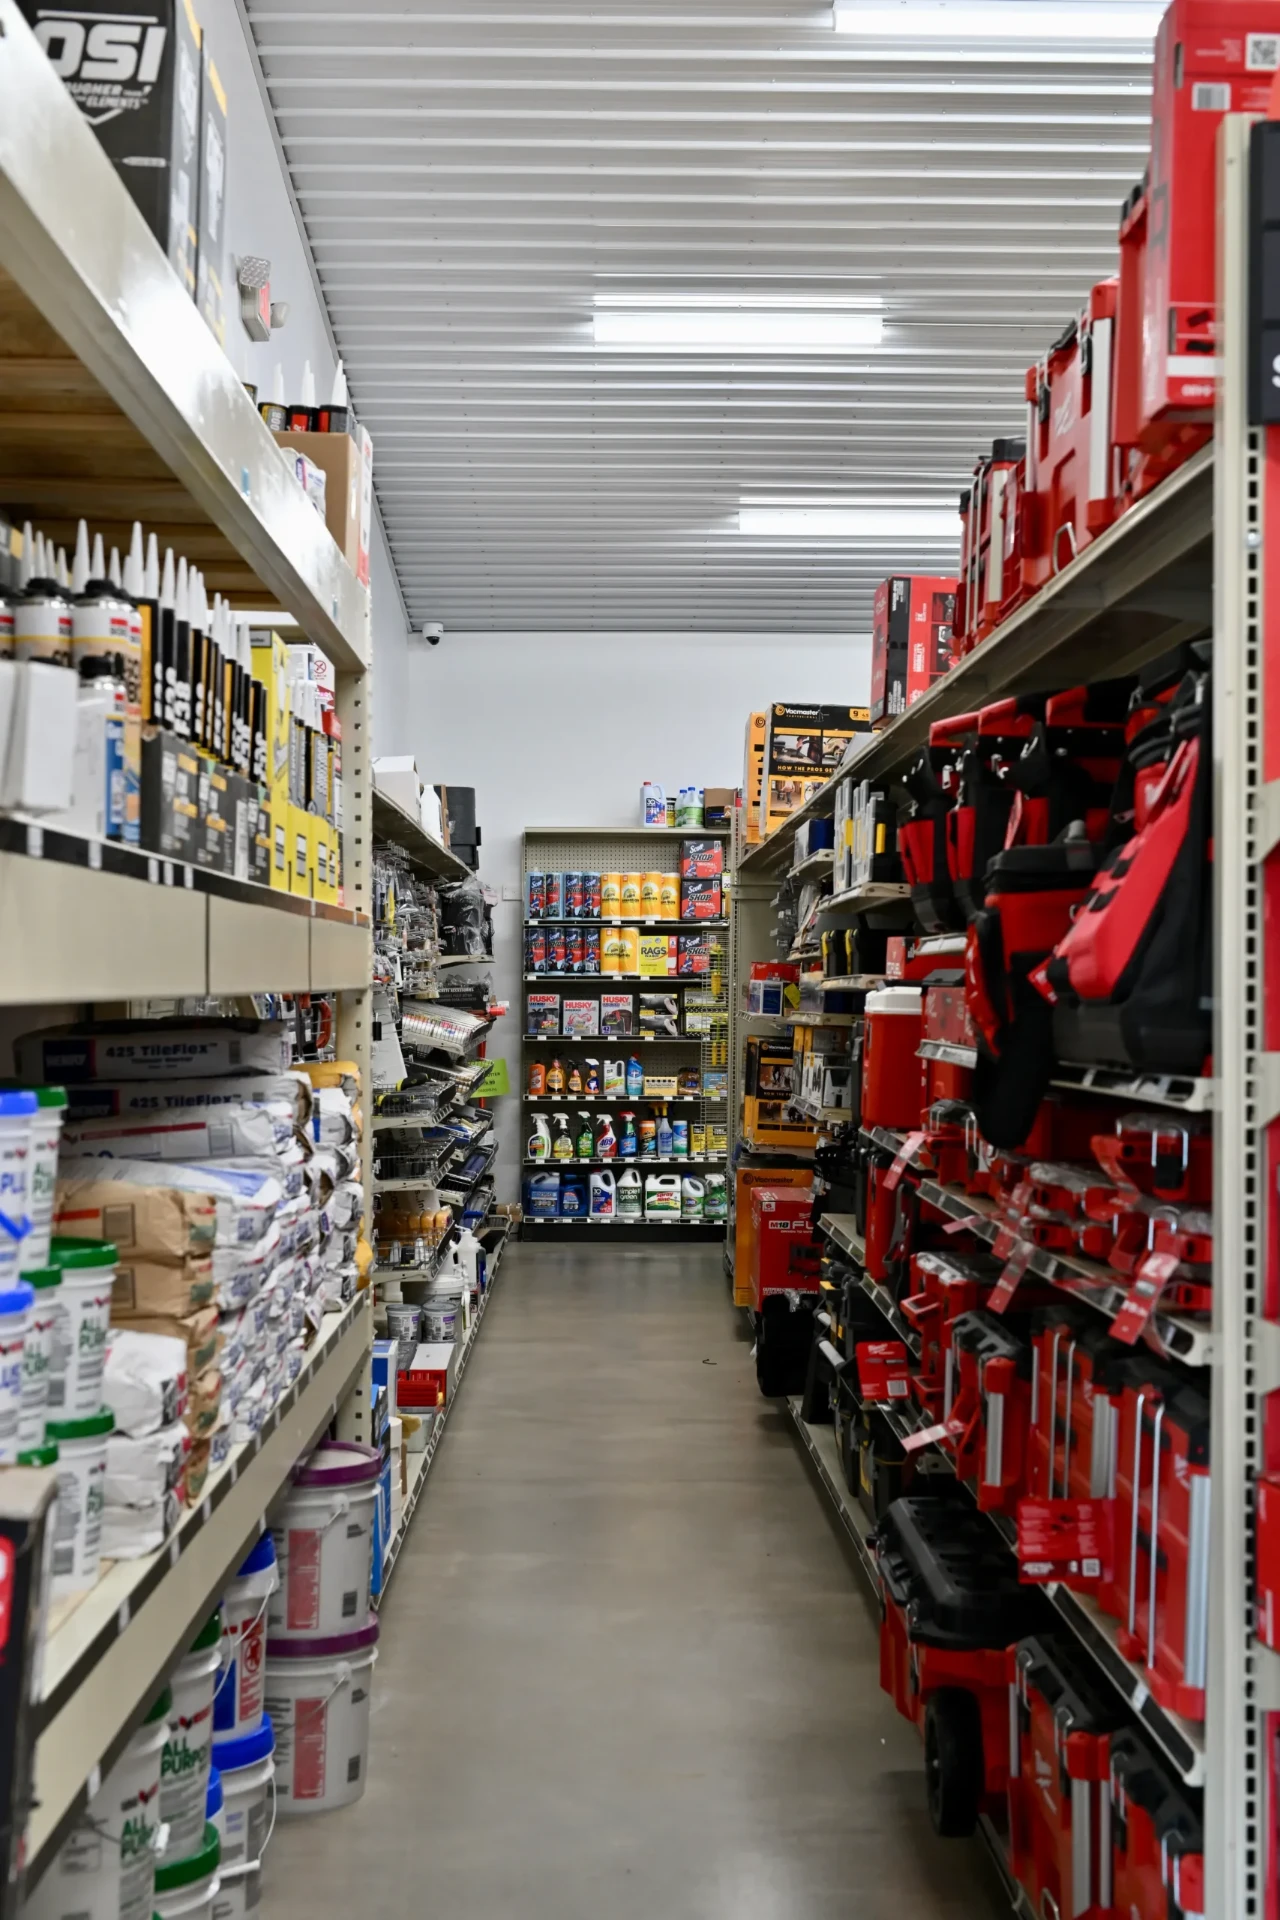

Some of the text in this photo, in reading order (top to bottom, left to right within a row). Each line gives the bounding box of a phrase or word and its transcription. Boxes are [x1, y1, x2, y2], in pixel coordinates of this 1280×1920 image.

[32, 20, 167, 82] OSI
[690, 853, 713, 862] SHOP
[688, 883, 703, 894] Scott
[688, 893, 712, 901] SHOP
[686, 937, 700, 948] Scott
[641, 947, 667, 955] RAGS
[529, 995, 556, 1003] HUSKY
[106, 1046, 135, 1058] 425
[130, 1097, 159, 1108] 425
[163, 1737, 190, 1757] ALL
